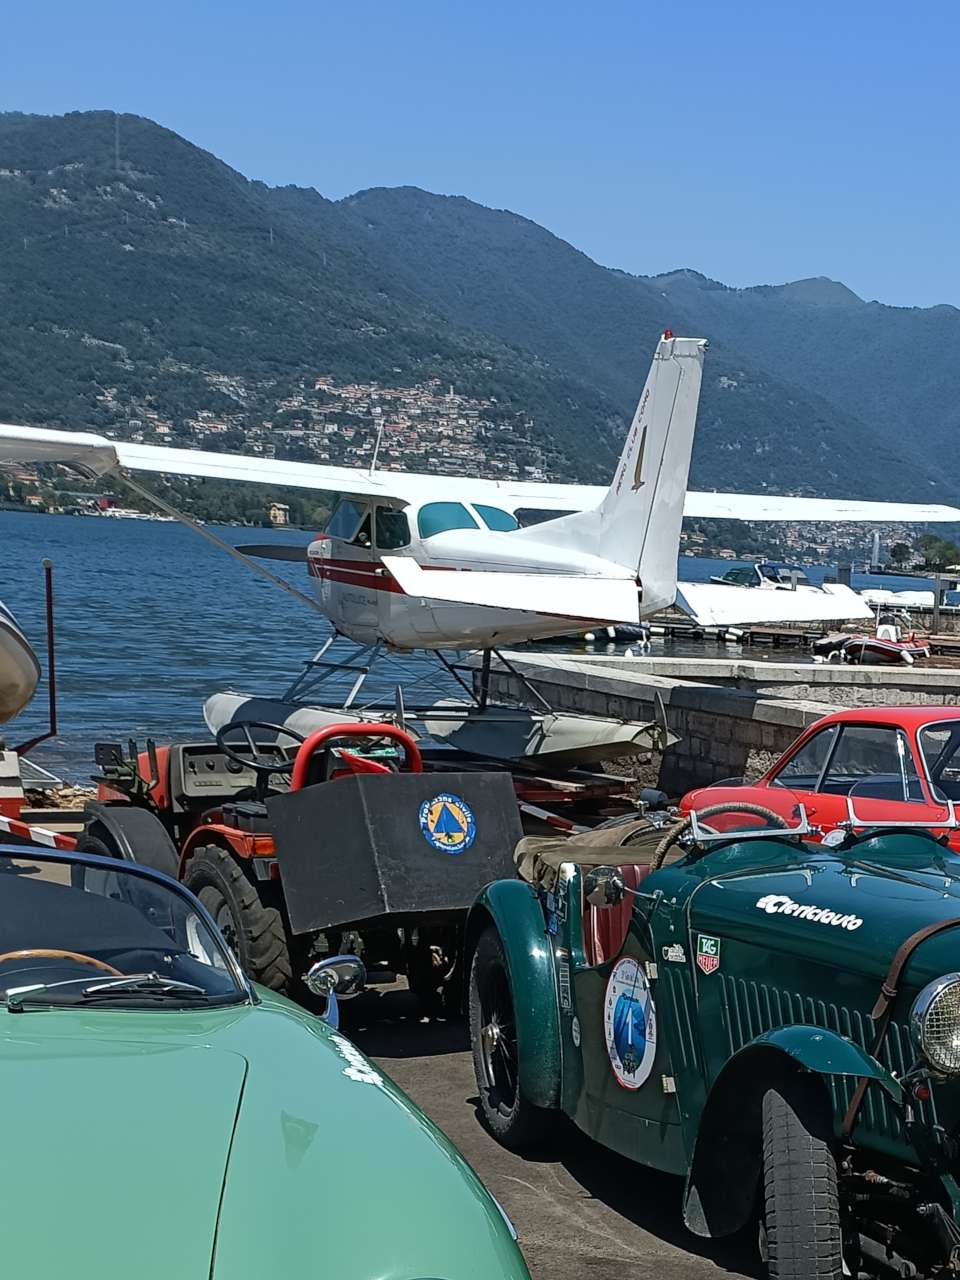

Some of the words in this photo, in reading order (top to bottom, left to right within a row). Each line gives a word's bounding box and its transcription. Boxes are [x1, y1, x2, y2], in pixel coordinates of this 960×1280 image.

[756, 895, 863, 931] Clericiauto
[701, 938, 717, 955] TAG
[697, 956, 718, 972] HEUER
[625, 1007, 633, 1045] 1
